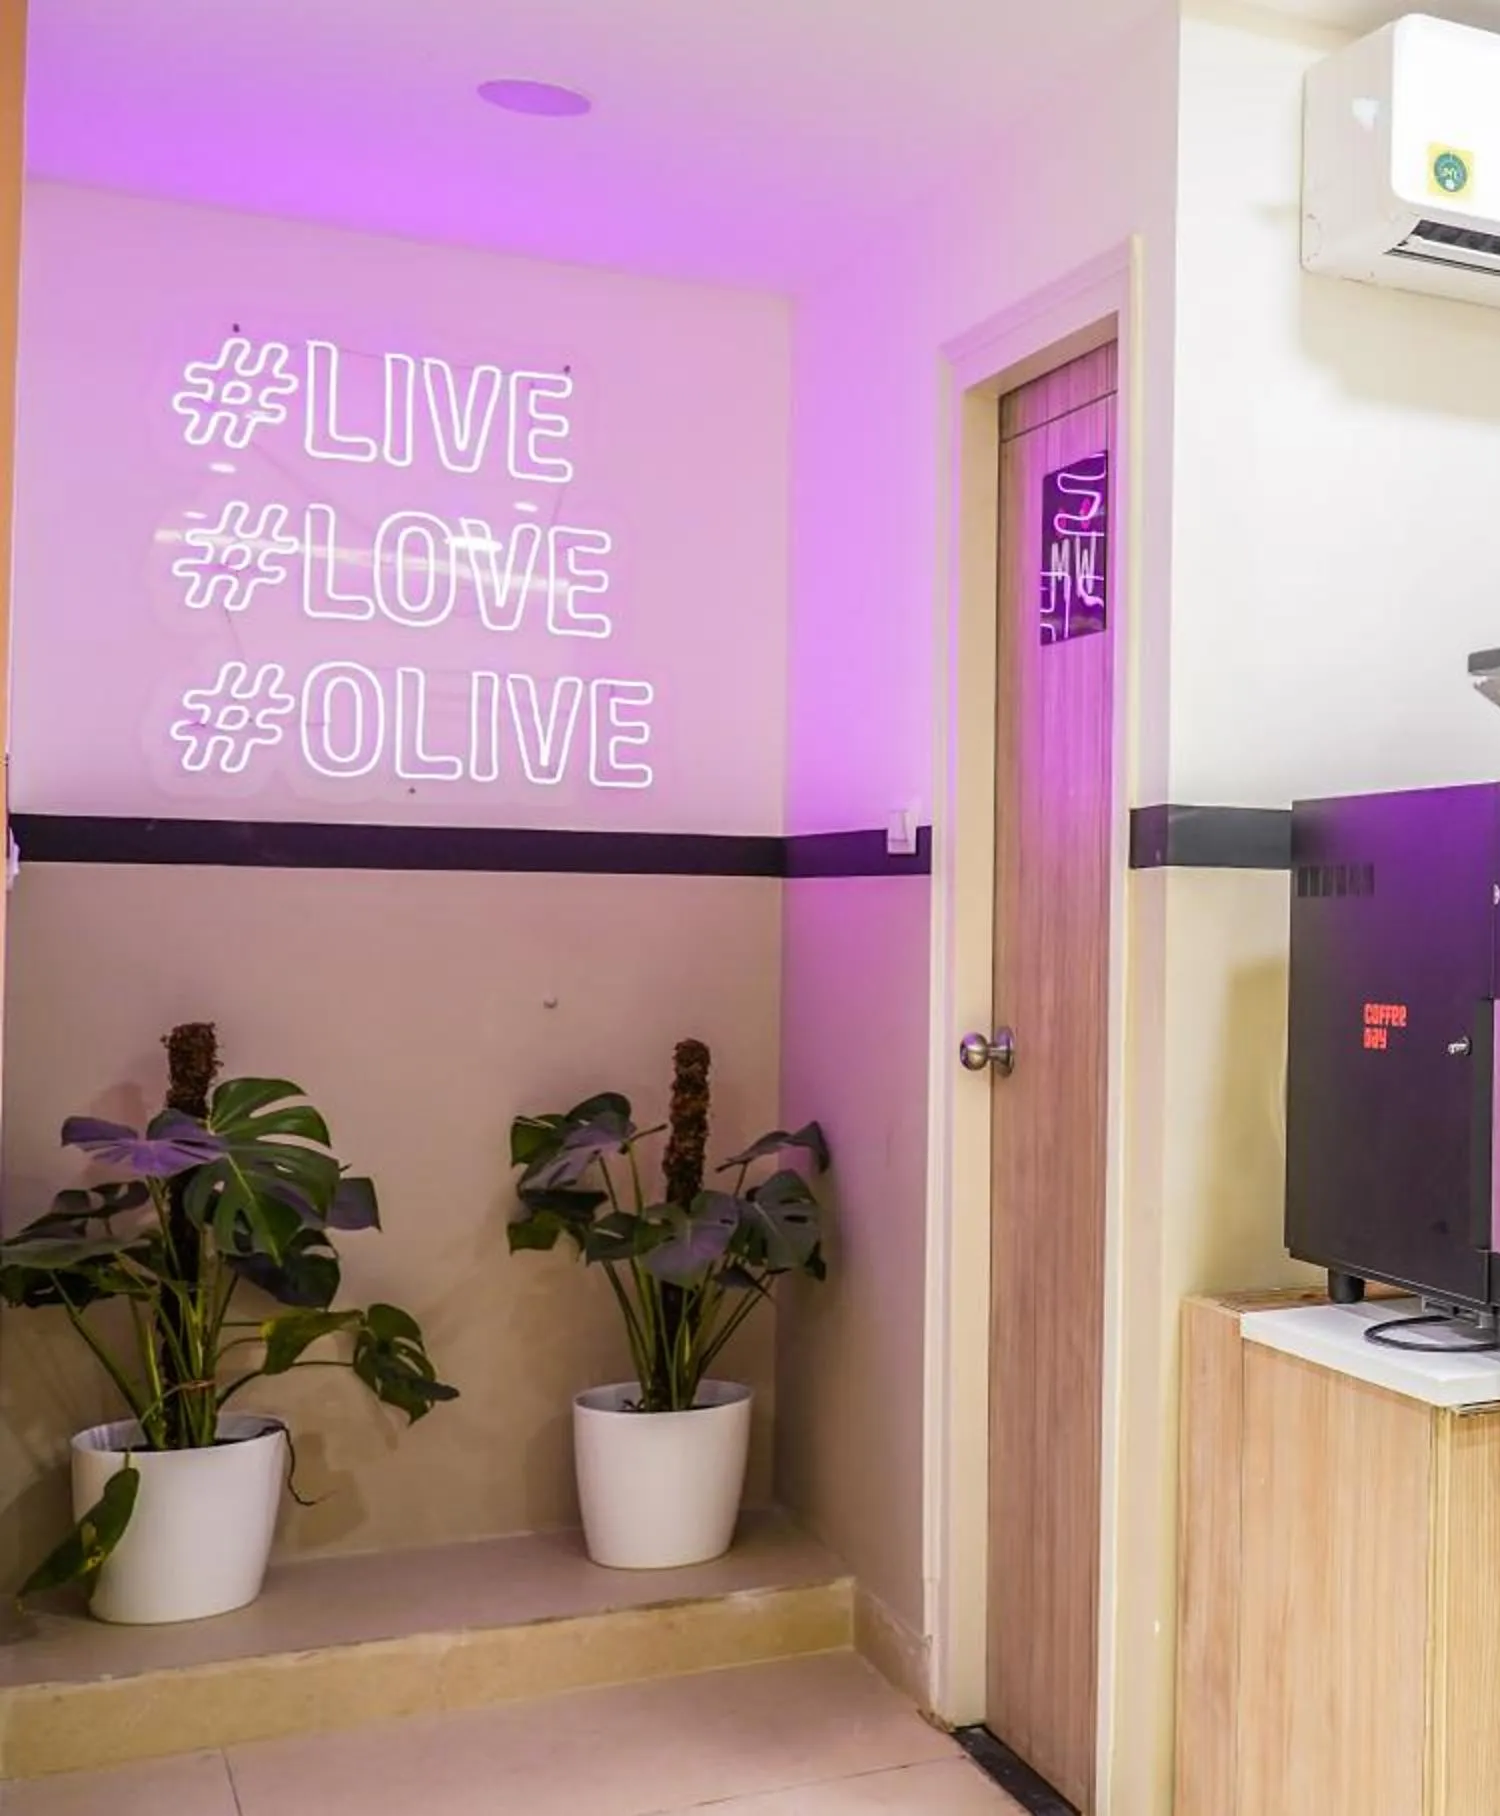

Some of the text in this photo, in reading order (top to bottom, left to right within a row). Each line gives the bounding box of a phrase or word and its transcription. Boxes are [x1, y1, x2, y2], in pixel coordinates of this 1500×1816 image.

[172, 337, 573, 483] #LIVE
[171, 500, 612, 639] #LOVE
[170, 661, 654, 788] #OLIVE
